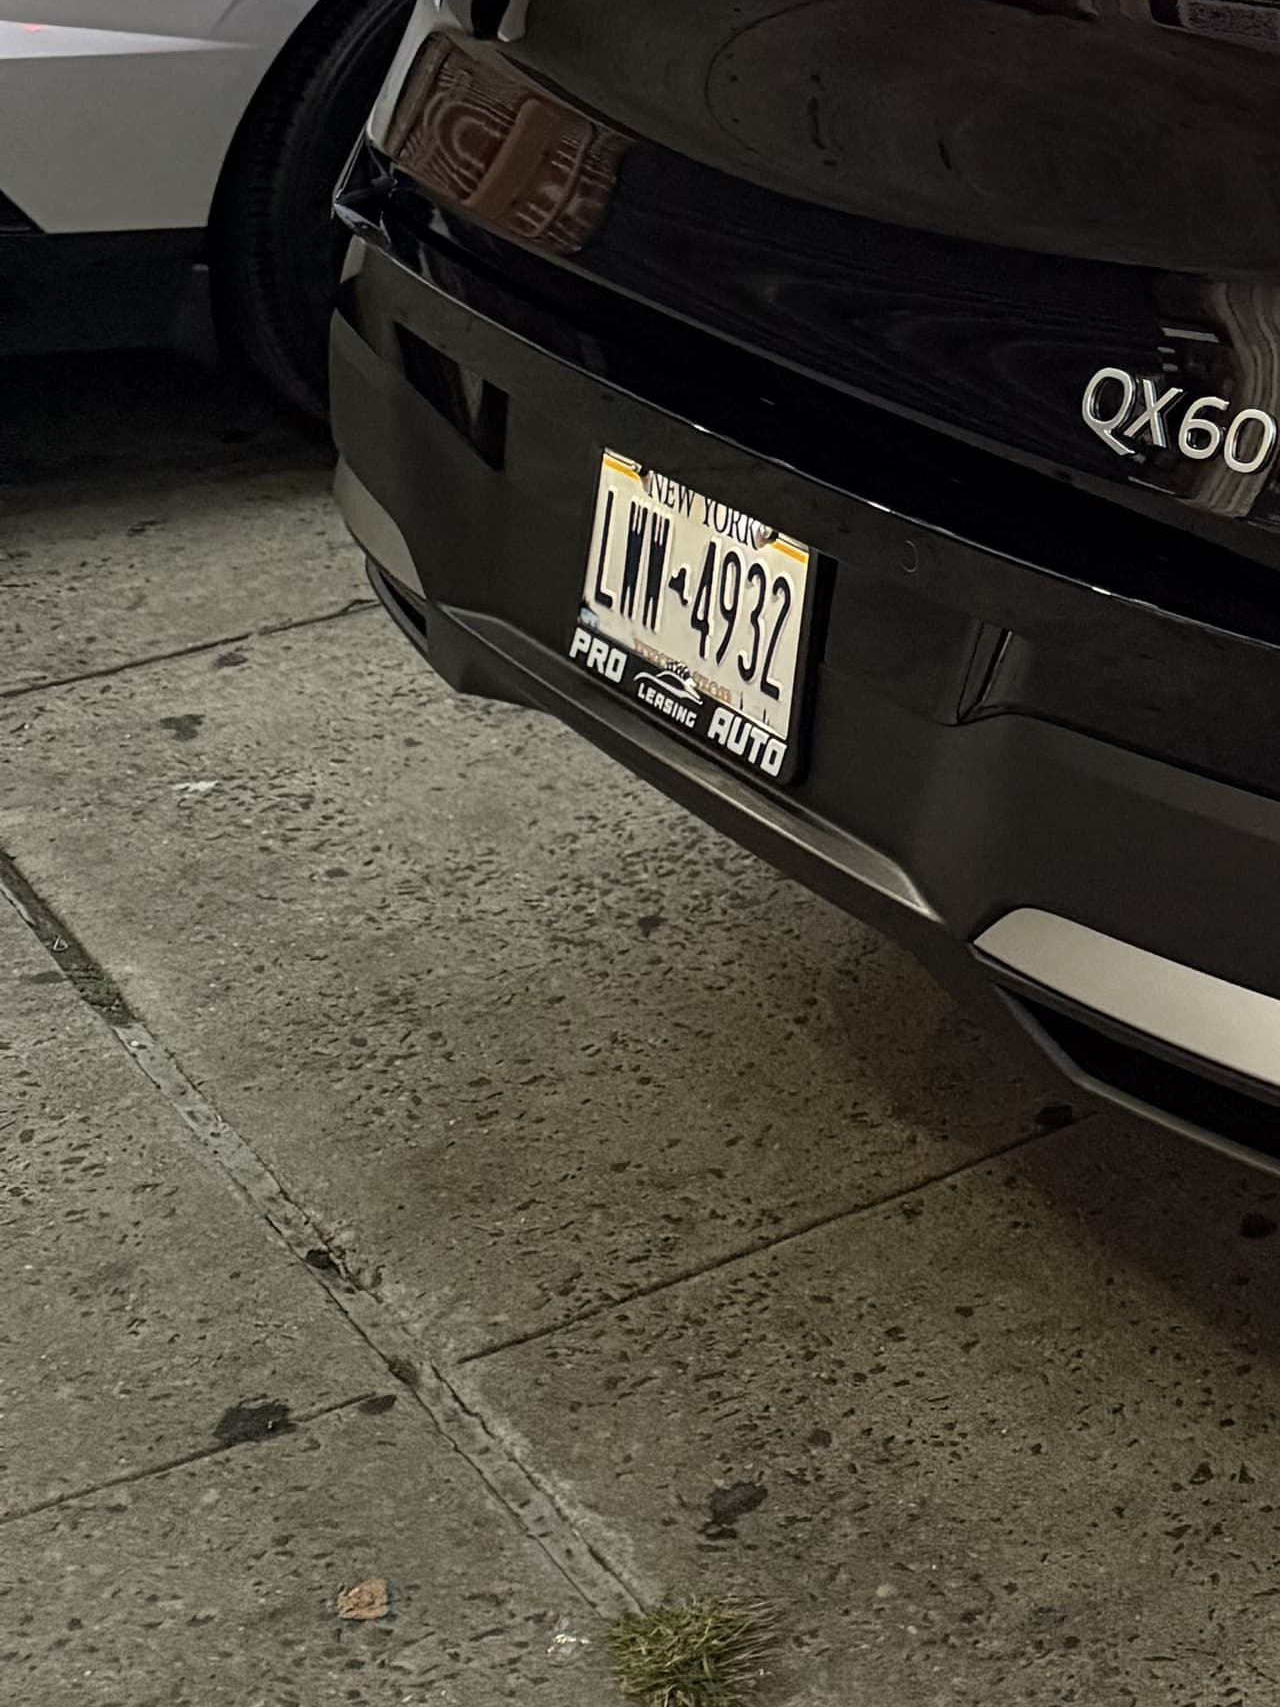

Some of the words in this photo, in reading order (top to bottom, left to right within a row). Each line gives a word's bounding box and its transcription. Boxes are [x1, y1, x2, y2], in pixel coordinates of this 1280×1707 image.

[1081, 366, 1277, 474] QX60
[647, 470, 696, 519] NEW
[701, 494, 759, 549] YORK
[690, 539, 792, 701] 4932
[568, 626, 628, 684] PRO
[707, 706, 788, 778] AUTO
[637, 682, 698, 730] LEASING
